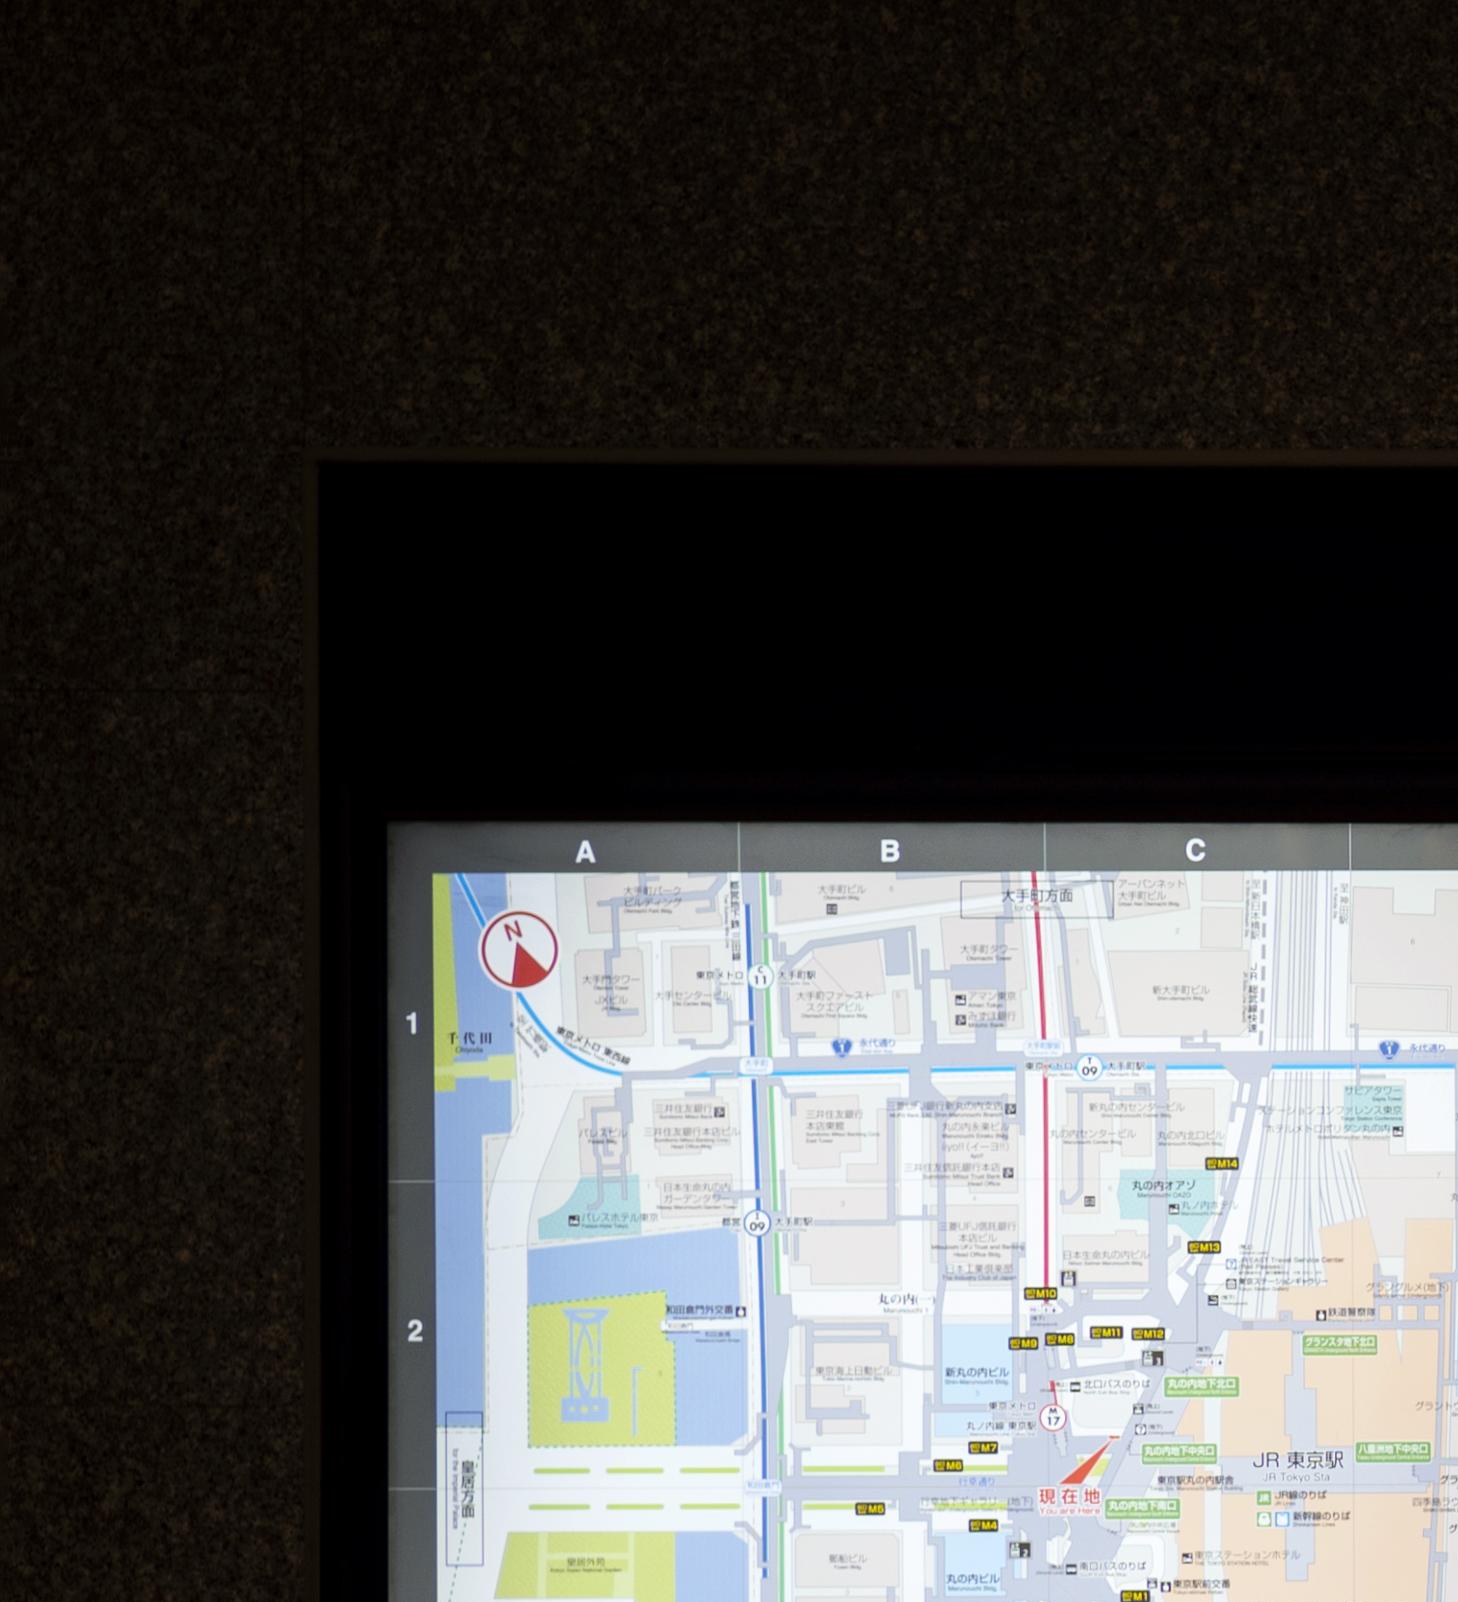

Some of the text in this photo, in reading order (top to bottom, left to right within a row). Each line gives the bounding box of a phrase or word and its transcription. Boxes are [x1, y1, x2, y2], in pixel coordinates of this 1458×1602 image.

[575, 839, 596, 864] A
[880, 838, 901, 863] B
[1185, 837, 1206, 863] C
[405, 1011, 417, 1035] 1
[407, 1318, 424, 1342] 2
[1252, 1450, 1344, 1470] JR 東京駅
[1039, 1488, 1101, 1505] 現在地
